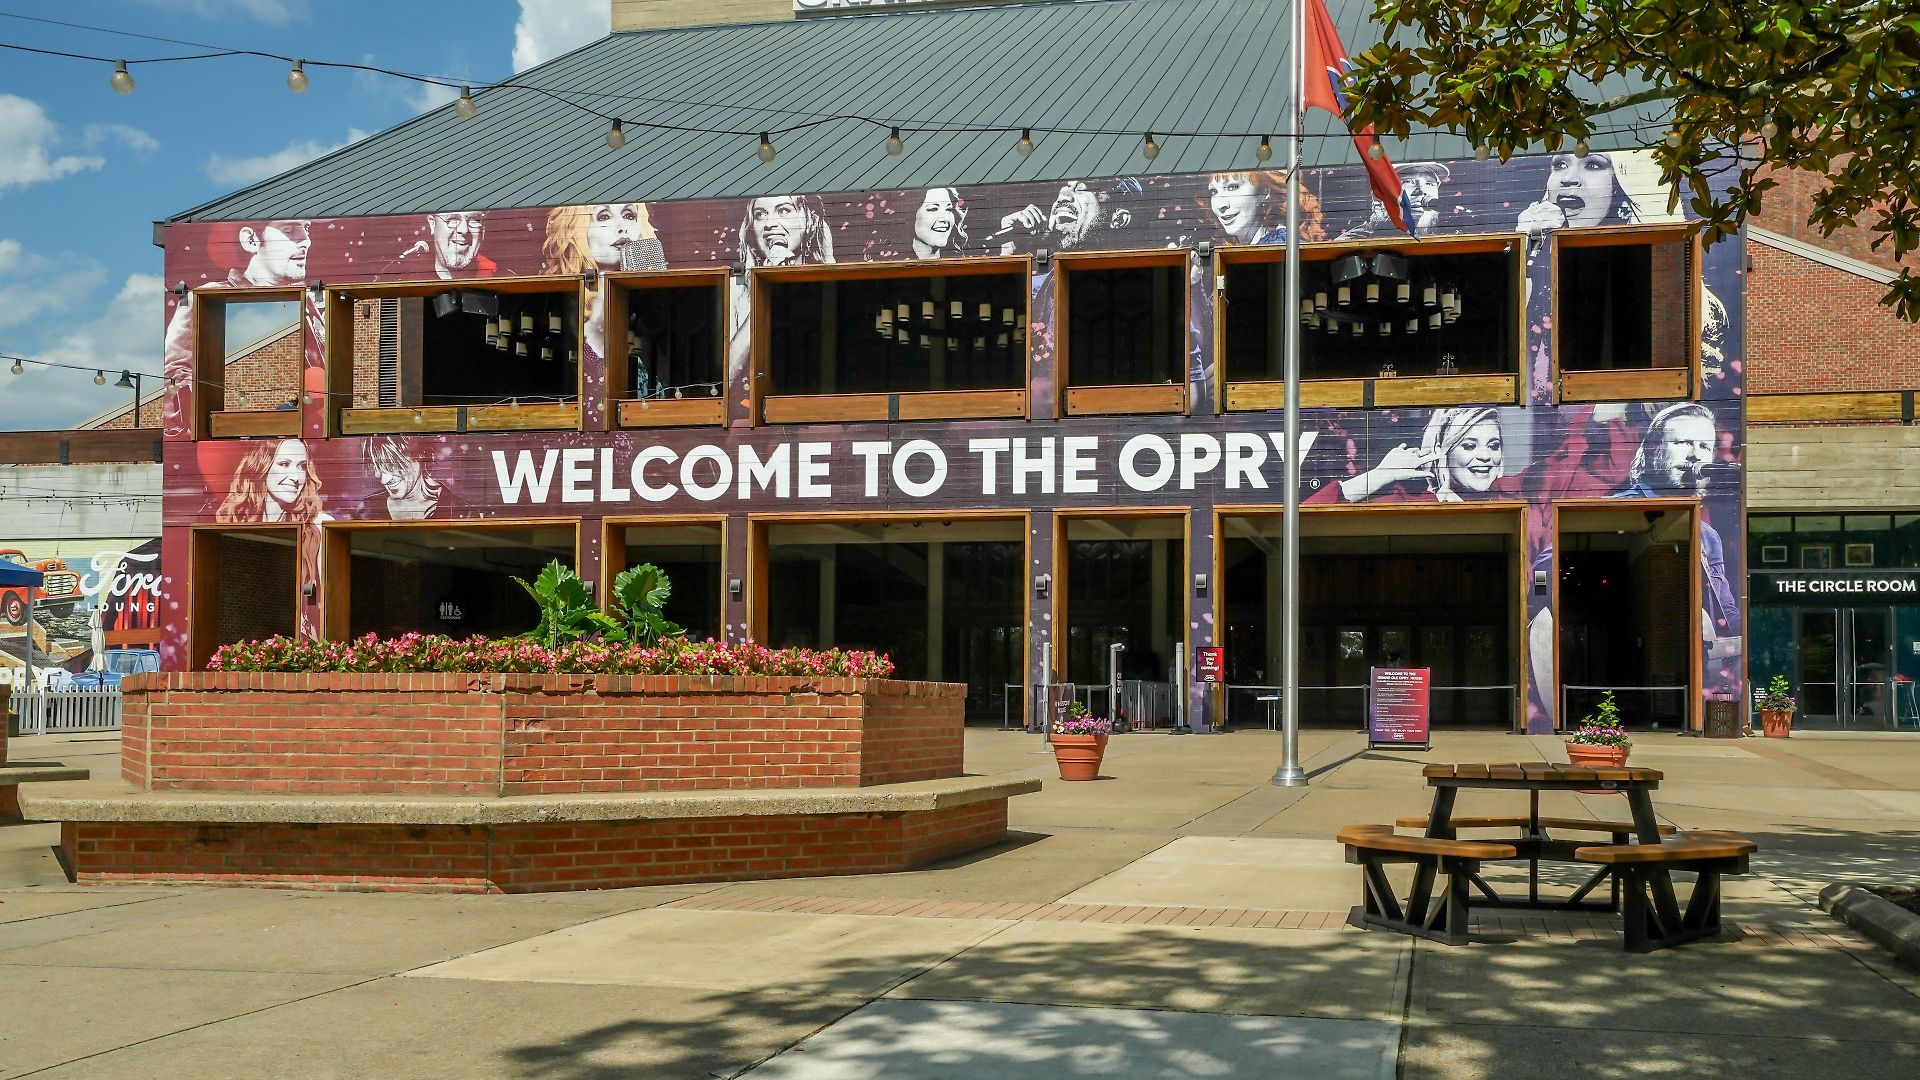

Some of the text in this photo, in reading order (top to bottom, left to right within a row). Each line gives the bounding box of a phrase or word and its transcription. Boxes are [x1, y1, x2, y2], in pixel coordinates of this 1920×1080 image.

[491, 431, 1319, 504] WELCOME TO THE OPRY
[1777, 580, 1916, 592] THE CIRCLE ROOM
